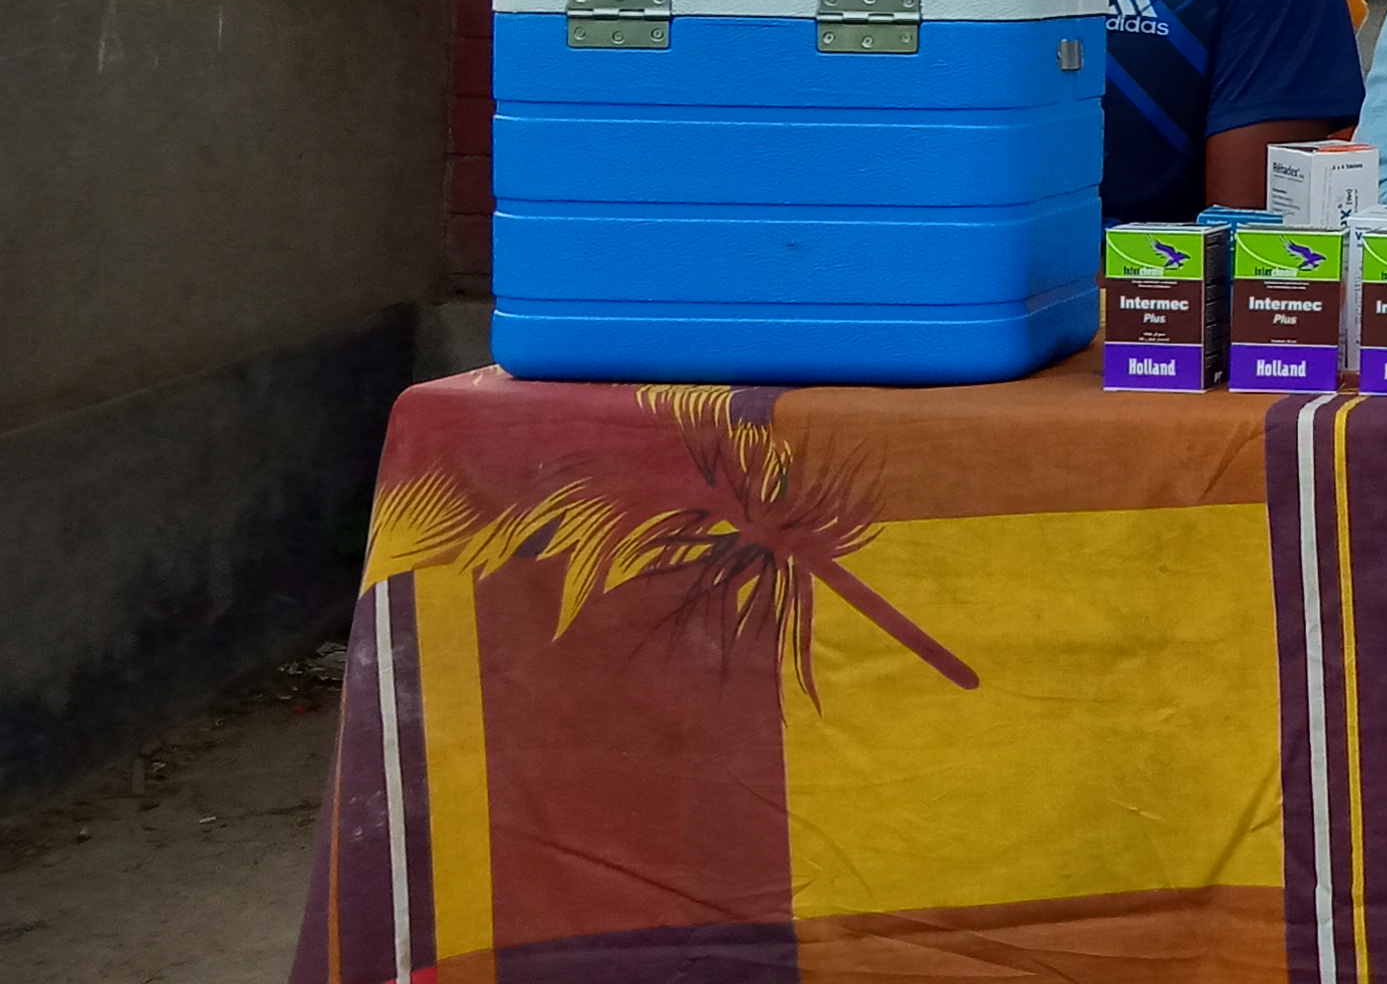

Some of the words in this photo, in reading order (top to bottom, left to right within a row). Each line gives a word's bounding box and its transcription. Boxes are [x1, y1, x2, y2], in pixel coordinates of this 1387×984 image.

[1106, 13, 1169, 36] adidas
[1120, 295, 1189, 311] Intermec
[1248, 296, 1323, 312] Intermec
[1143, 313, 1166, 324] Plus
[1273, 313, 1297, 325] Plus
[1128, 358, 1176, 376] Holland
[1256, 359, 1307, 377] Holland
